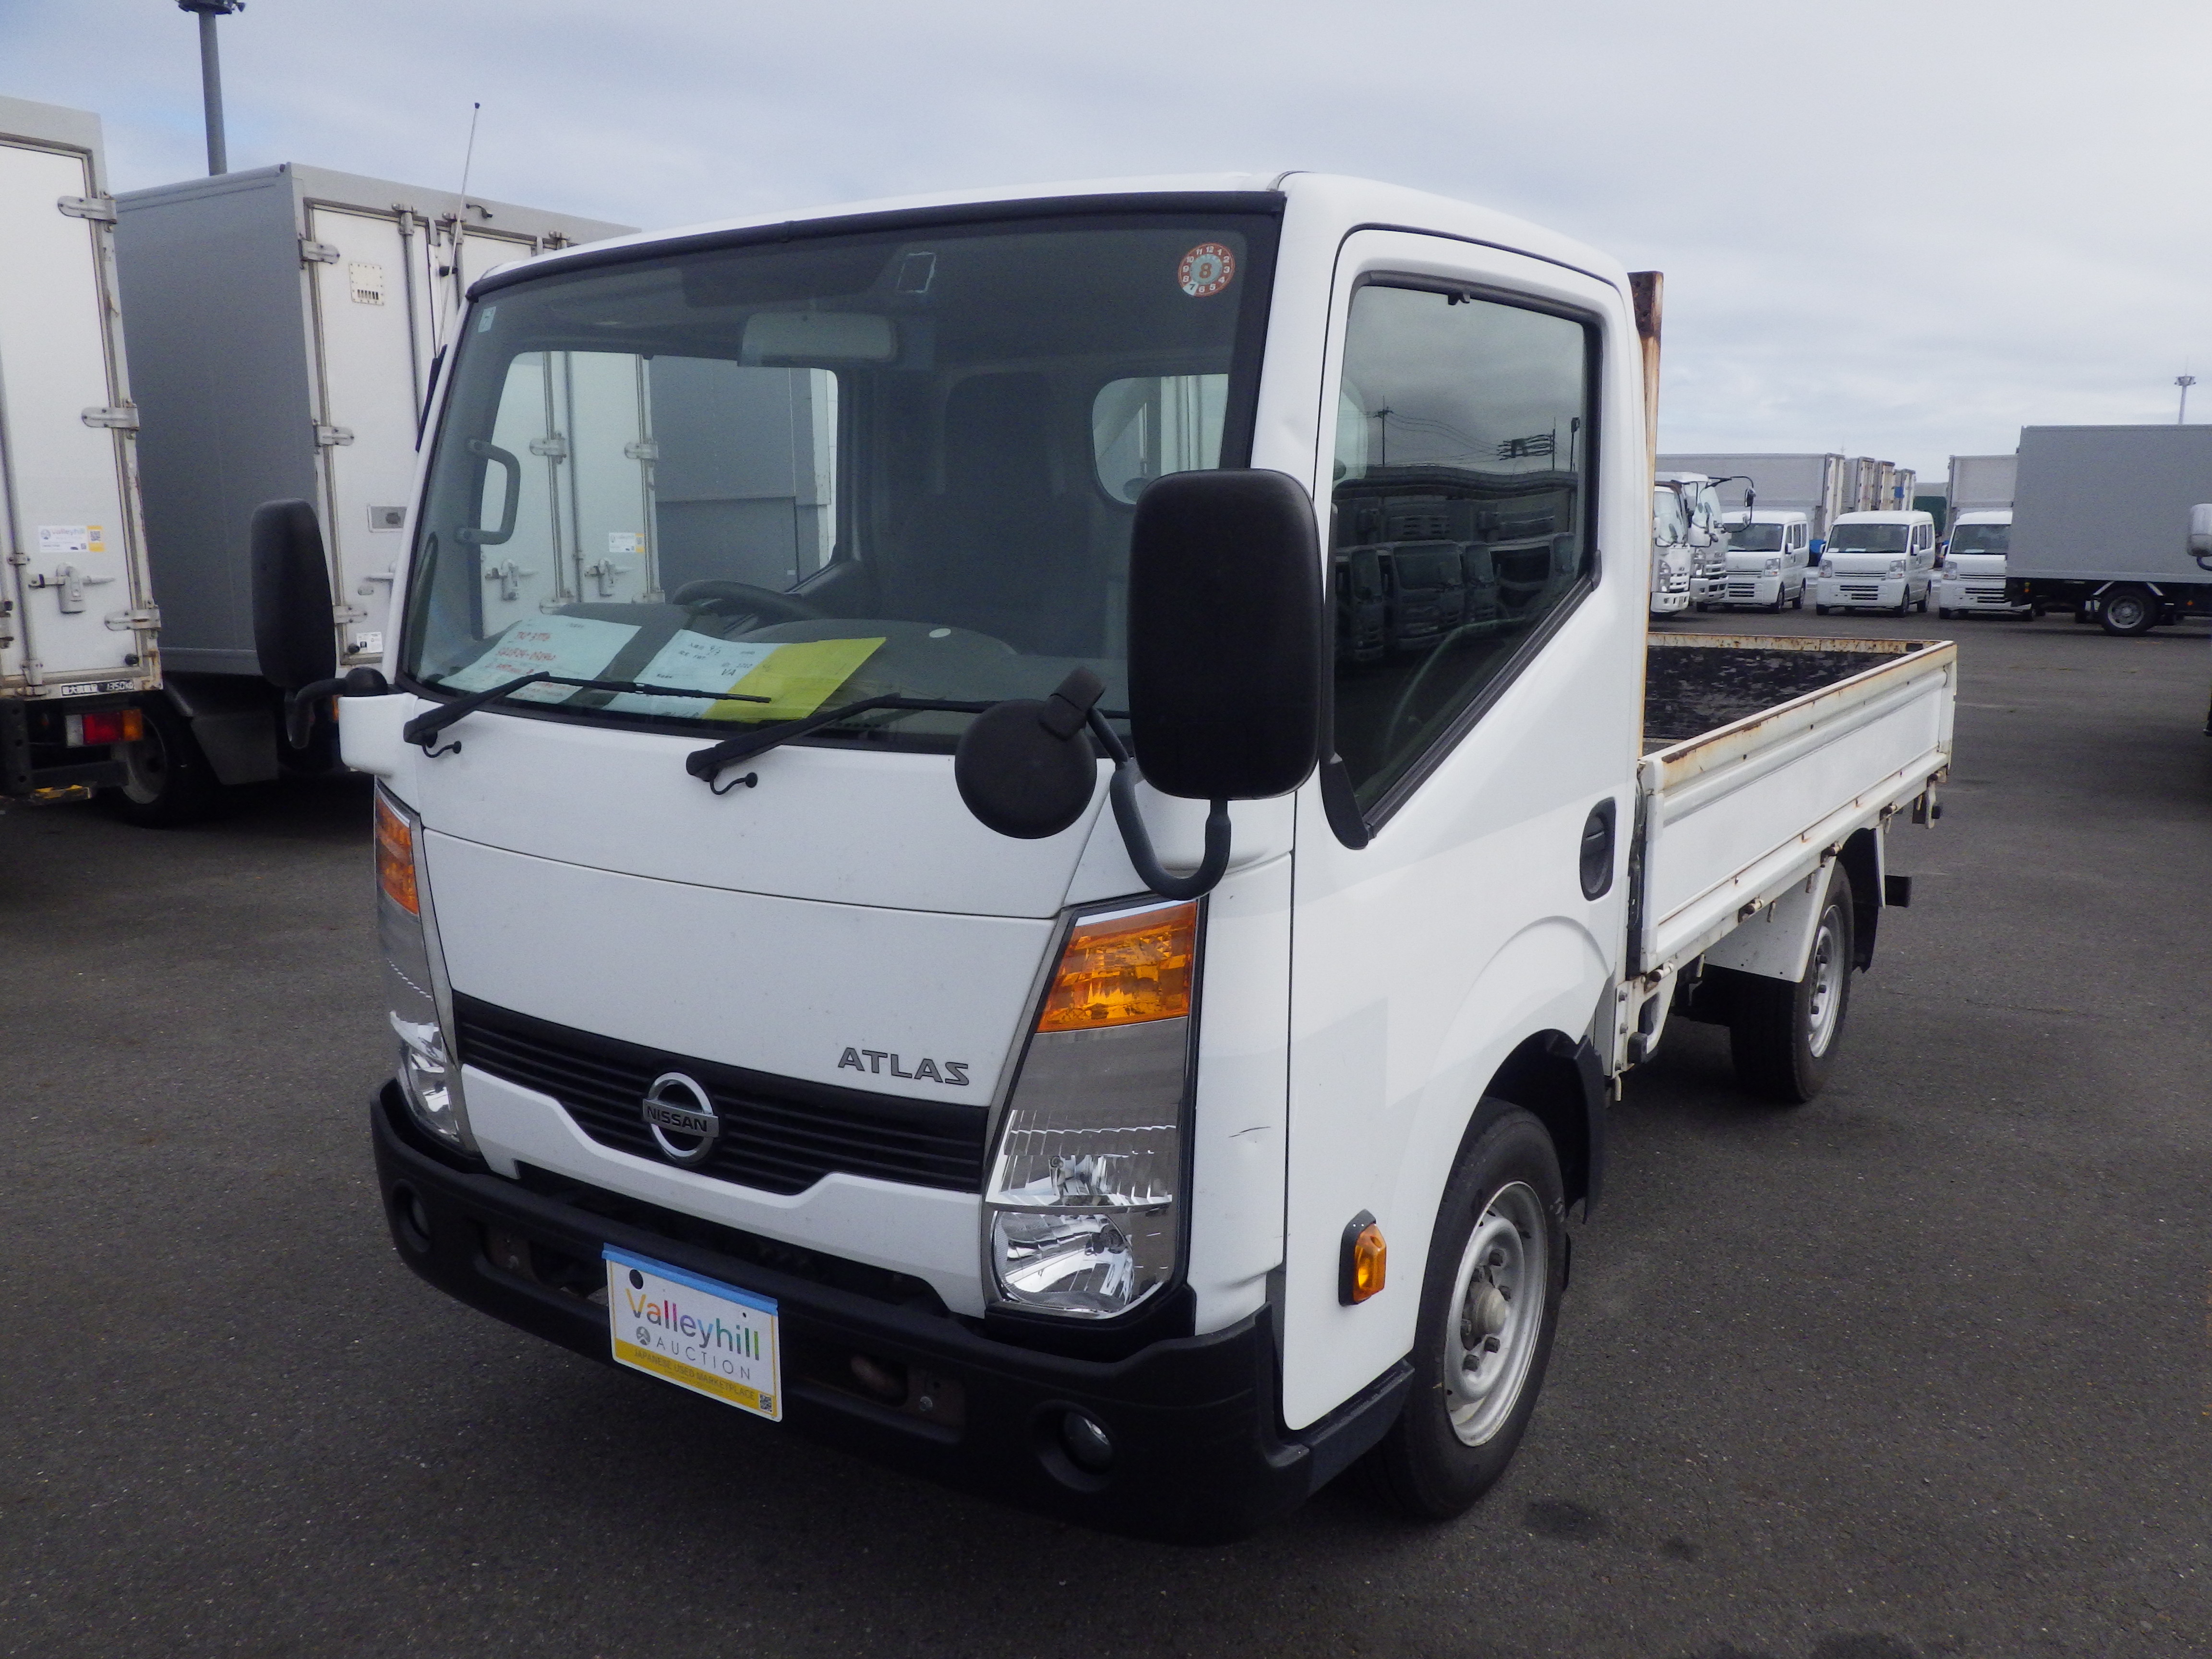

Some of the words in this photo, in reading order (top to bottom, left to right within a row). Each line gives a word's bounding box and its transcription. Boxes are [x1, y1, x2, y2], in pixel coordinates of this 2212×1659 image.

[1199, 263, 1212, 278] 8
[838, 1047, 969, 1086] ATLAS
[647, 1106, 707, 1133] NISSAN
[625, 1288, 759, 1360] Valleyhill
[634, 1349, 672, 1369] JAPANESE
[674, 1364, 695, 1378] USED
[697, 1372, 755, 1399] MARKETPLACE
[656, 1336, 750, 1380] AUCTION
